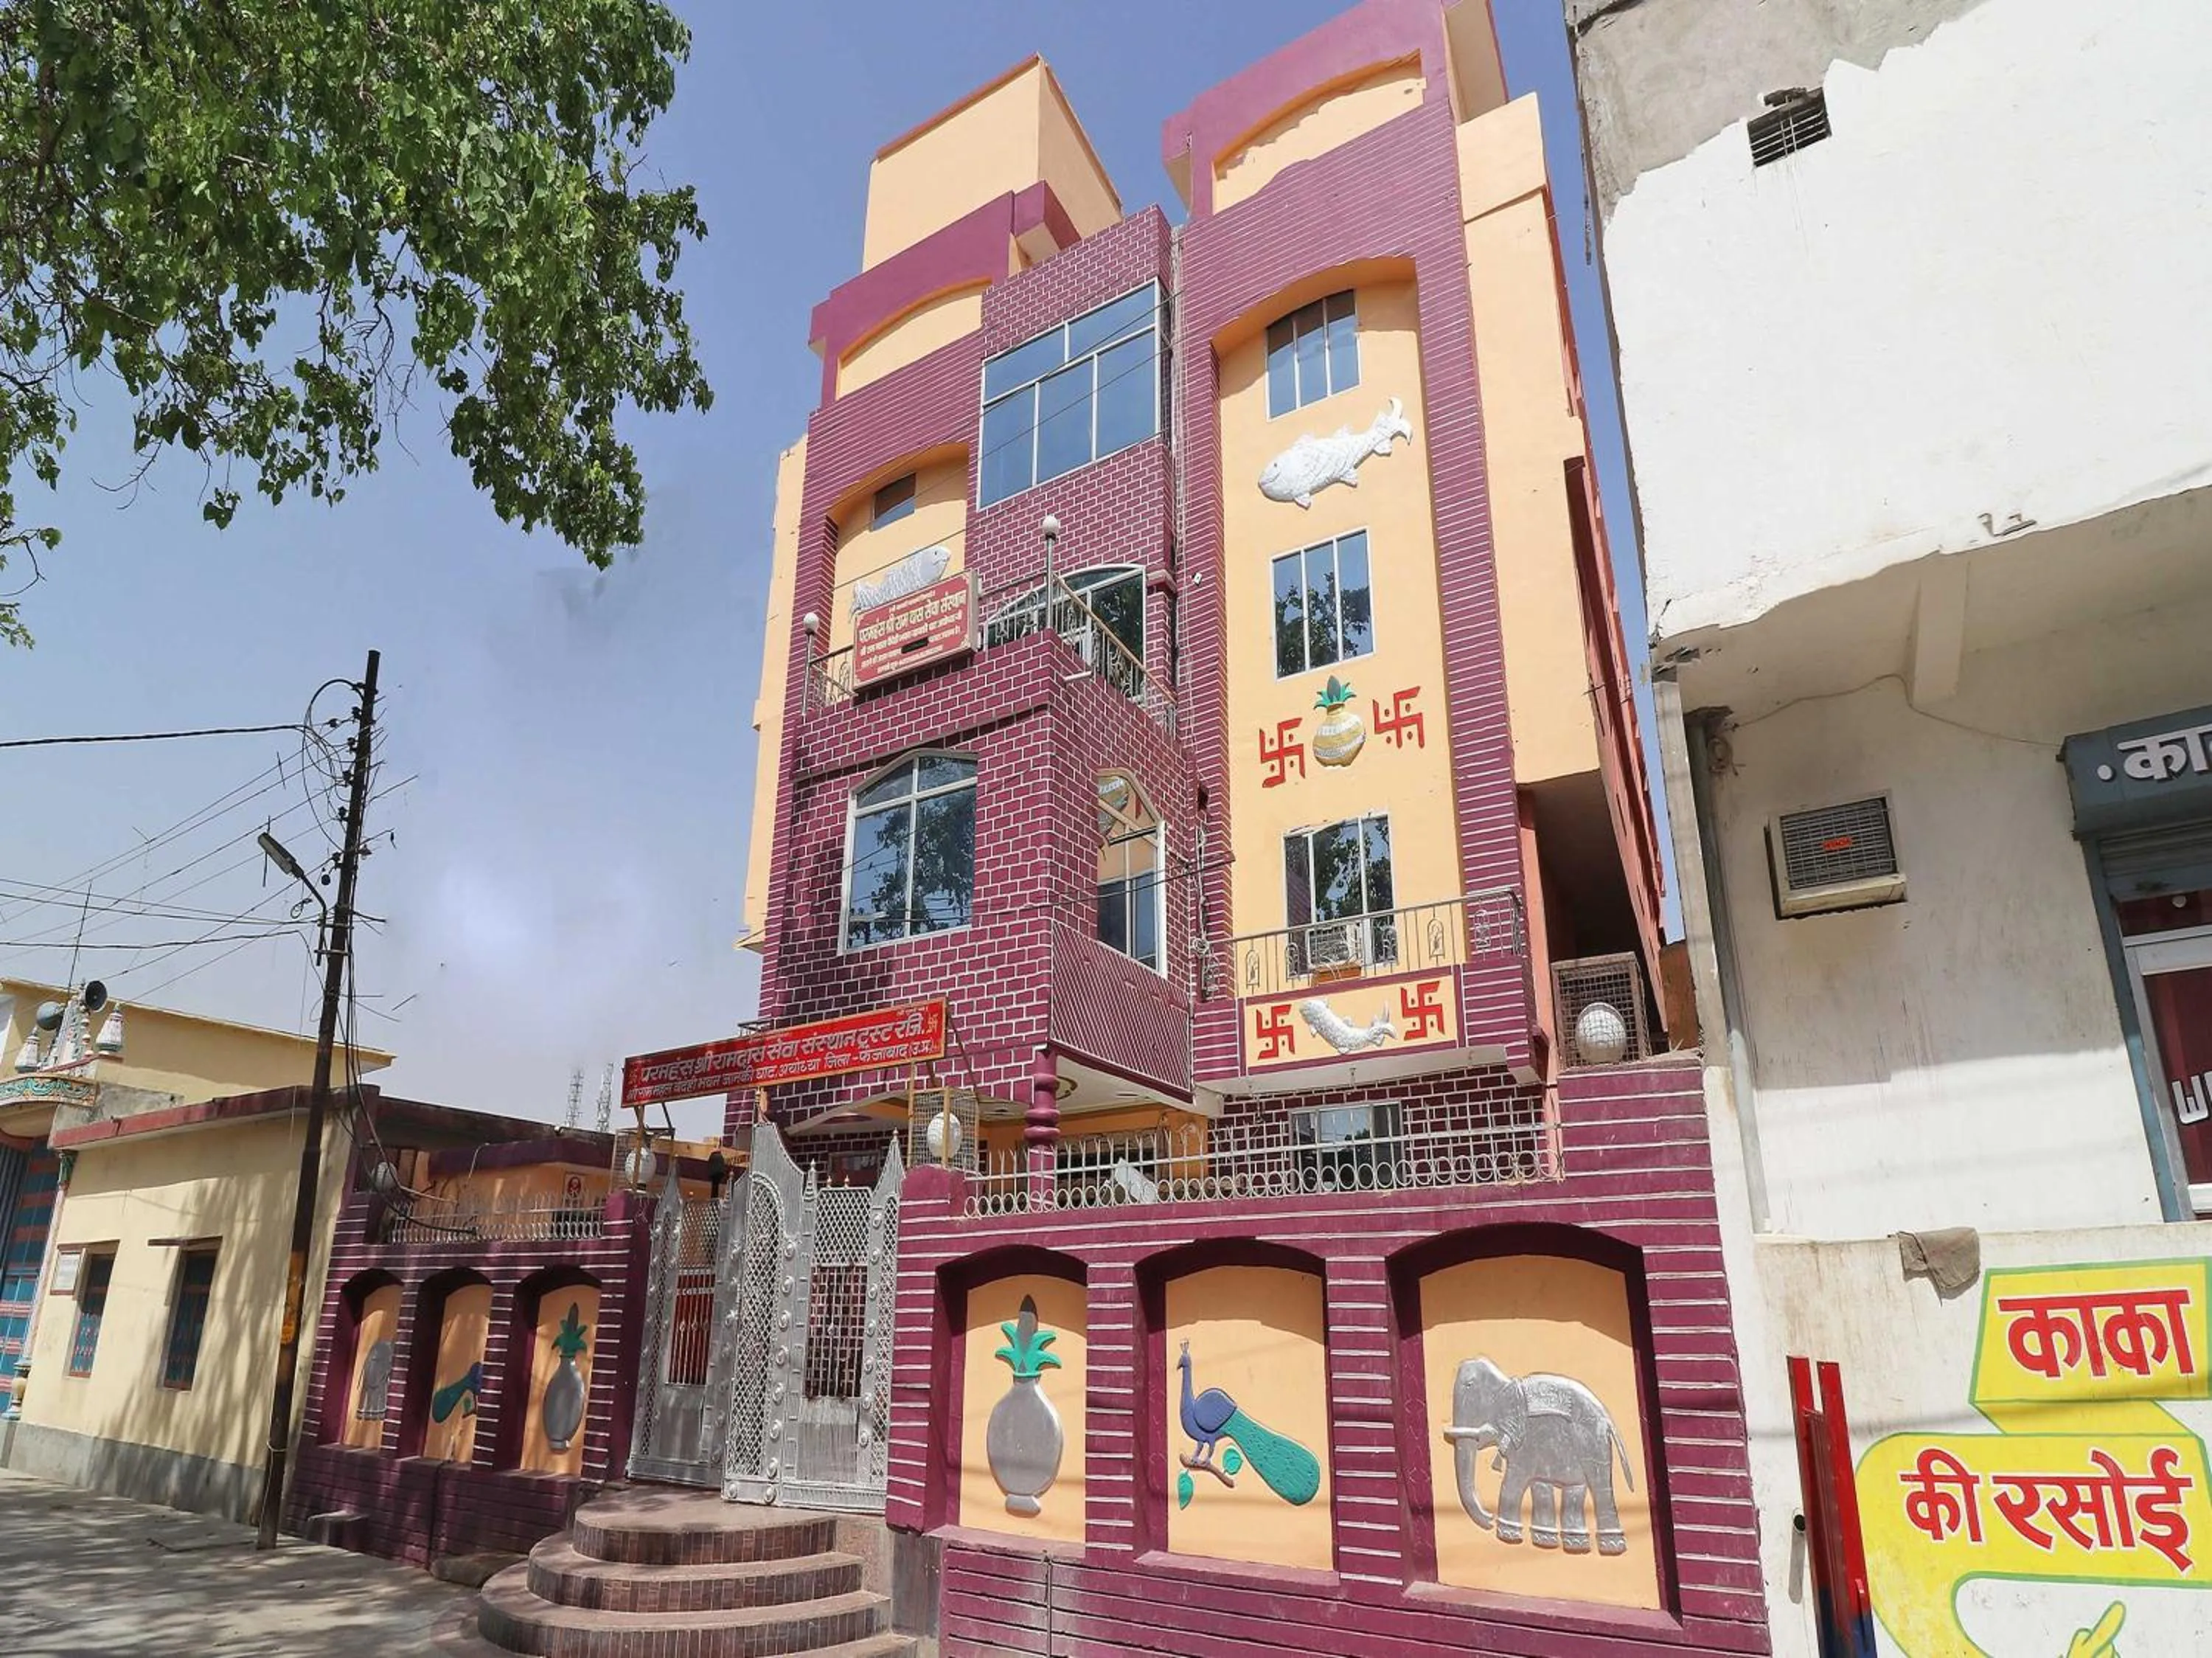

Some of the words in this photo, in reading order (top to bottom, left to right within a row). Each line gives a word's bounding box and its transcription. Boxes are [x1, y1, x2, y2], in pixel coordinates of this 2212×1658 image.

[766, 1038, 798, 1060] सेवा
[801, 1032, 855, 1054] संस्थान
[1998, 1289, 2194, 1378] काका
[1899, 1448, 1983, 1543] की
[1992, 1448, 2194, 1572] रसोई
